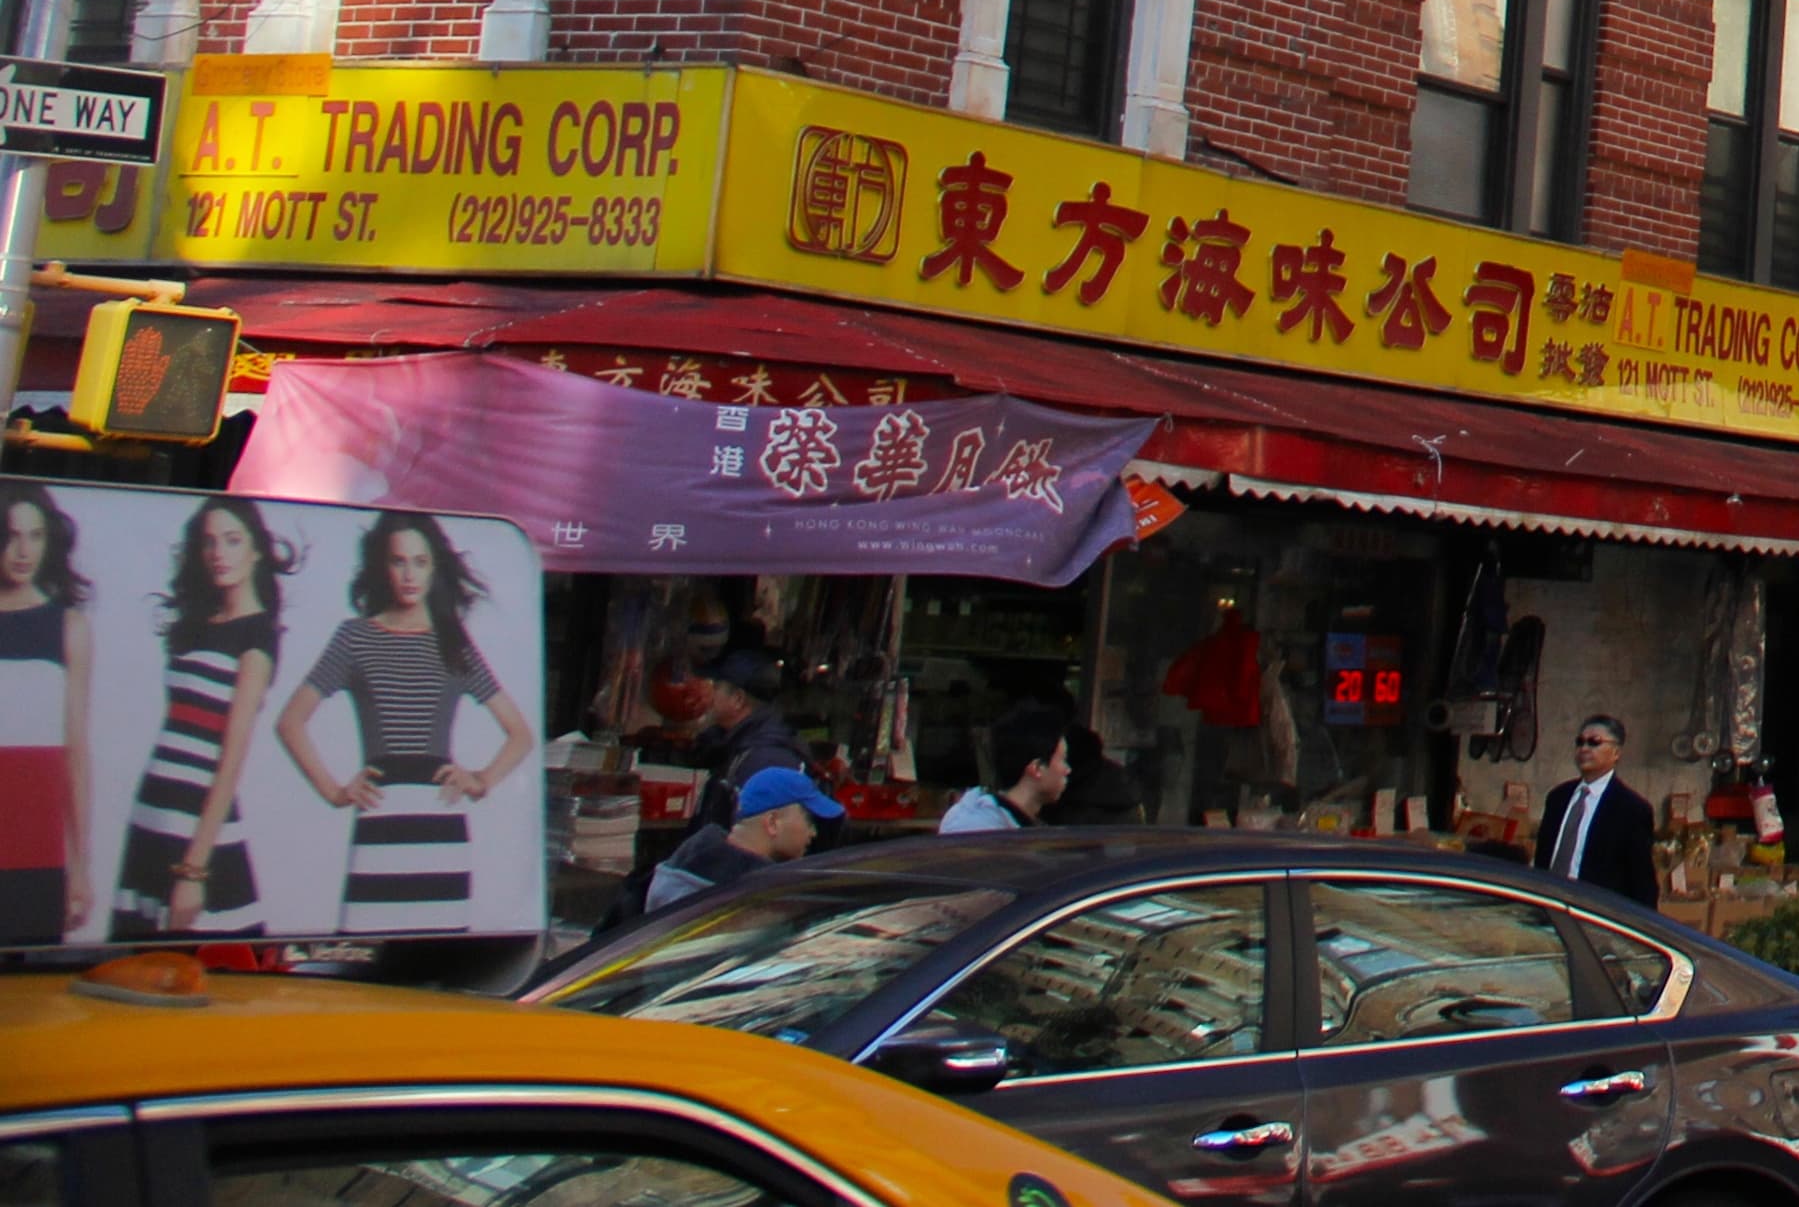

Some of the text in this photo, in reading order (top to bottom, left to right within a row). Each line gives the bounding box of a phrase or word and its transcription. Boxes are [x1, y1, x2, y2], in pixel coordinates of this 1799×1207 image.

[76, 96, 136, 133] WAY
[192, 101, 679, 177] A.T. TRADING CORP.
[186, 191, 226, 238] 121
[234, 191, 328, 241] MOTT
[332, 192, 377, 242] ST.
[448, 195, 661, 247] (212)925-8333
[918, 150, 1536, 375] 東方海味公司
[1617, 287, 1663, 348] A.T.
[1675, 295, 1772, 367] TRADING
[1617, 358, 1640, 396] 121
[1646, 359, 1691, 405] MOTT
[1694, 368, 1715, 408] ST.
[552, 521, 687, 552] 世界
[794, 519, 841, 530] HONG
[847, 519, 890, 531] KONG
[1335, 670, 1402, 703] 20 60
